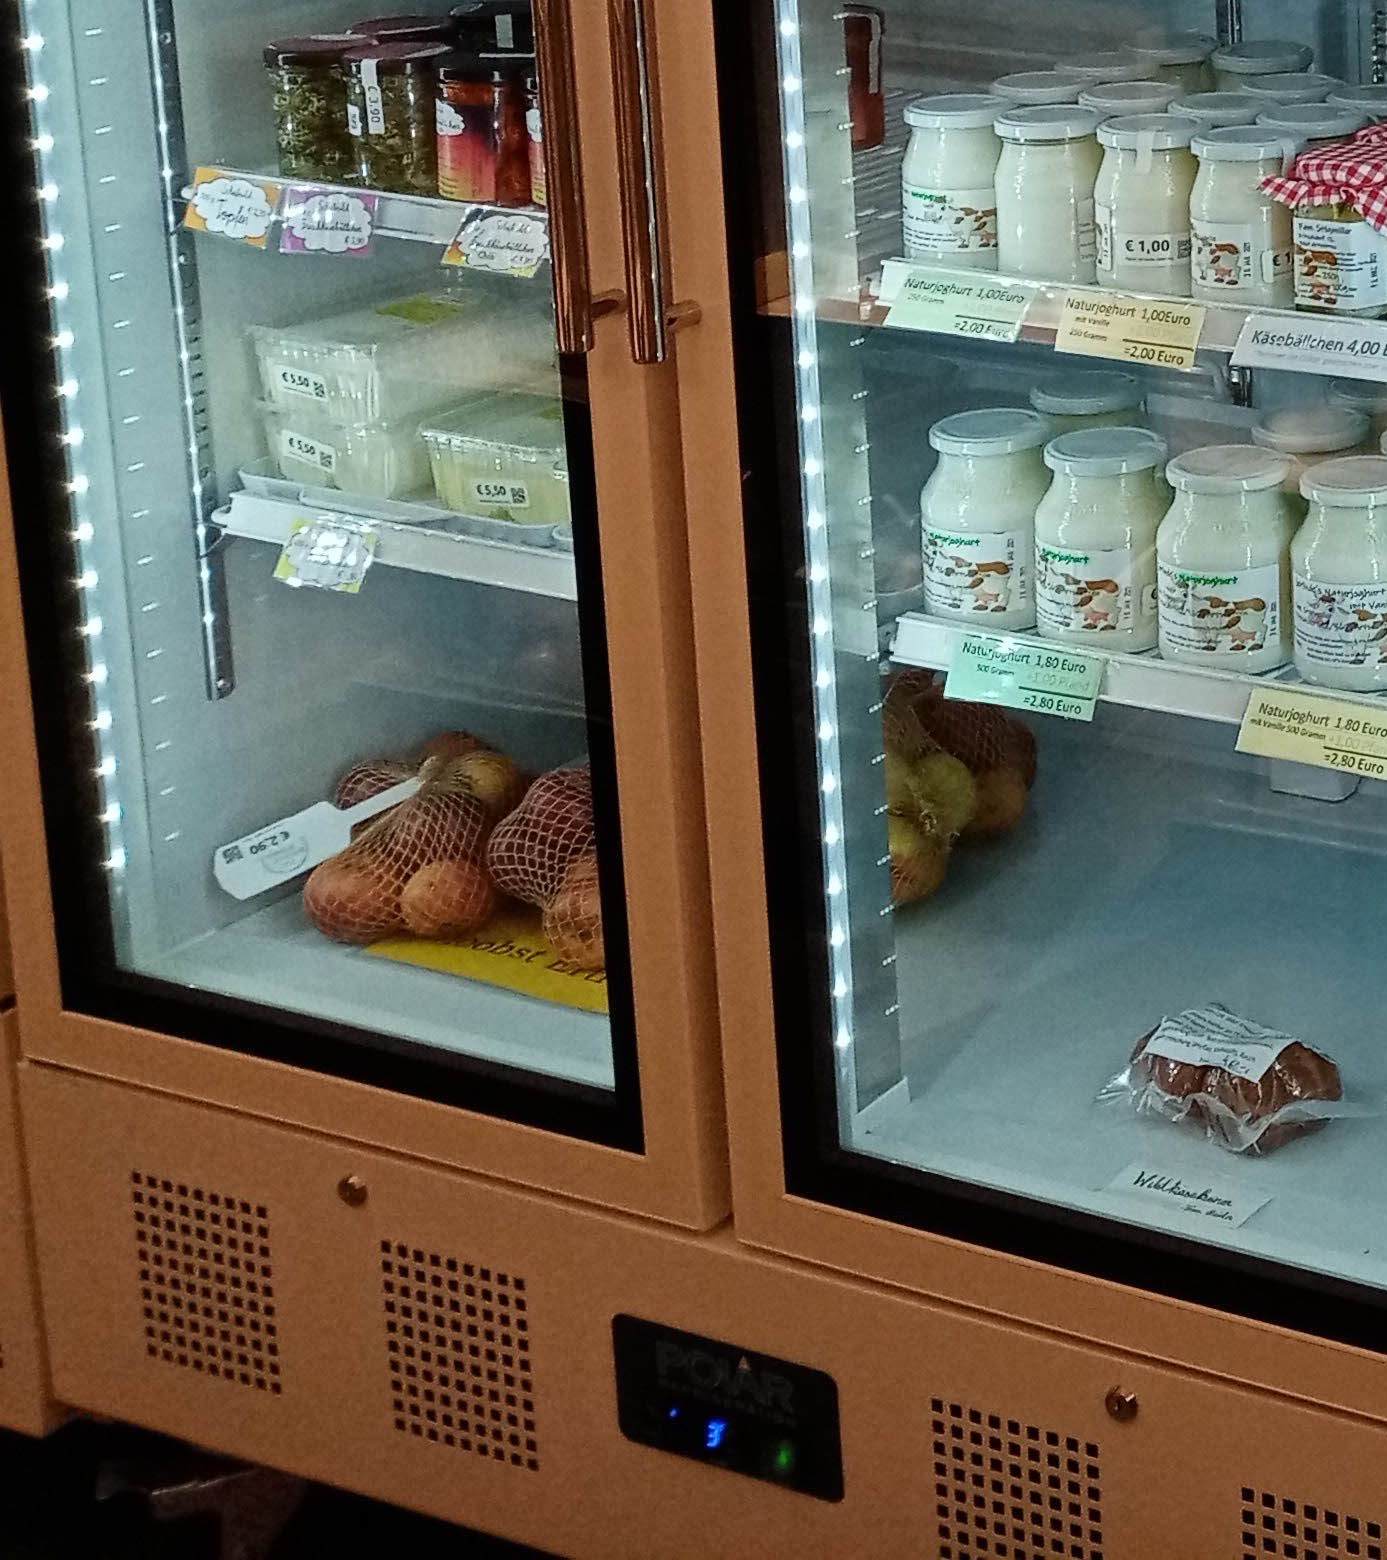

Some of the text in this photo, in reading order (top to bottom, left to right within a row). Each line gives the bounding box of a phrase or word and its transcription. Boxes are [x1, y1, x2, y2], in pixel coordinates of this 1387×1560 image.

[1138, 240, 1170, 254] 1,00
[903, 276, 974, 298] Naturjoghurt
[1065, 296, 1136, 318] Naturjoghurt
[1251, 329, 1343, 353] Käsebällchen
[1346, 339, 1380, 356] 4,00
[1124, 345, 1185, 366] =2,00 Euro
[290, 372, 310, 389] 5,50
[296, 438, 316, 456] 5,50
[485, 484, 507, 497] 5,50
[961, 641, 1087, 674] Naturjoghurt 1,80 Euro
[1023, 696, 1082, 716] =2,80 Euro
[1258, 702, 1330, 728] Naturjoghurt
[1323, 753, 1384, 775] =2,80 Euro
